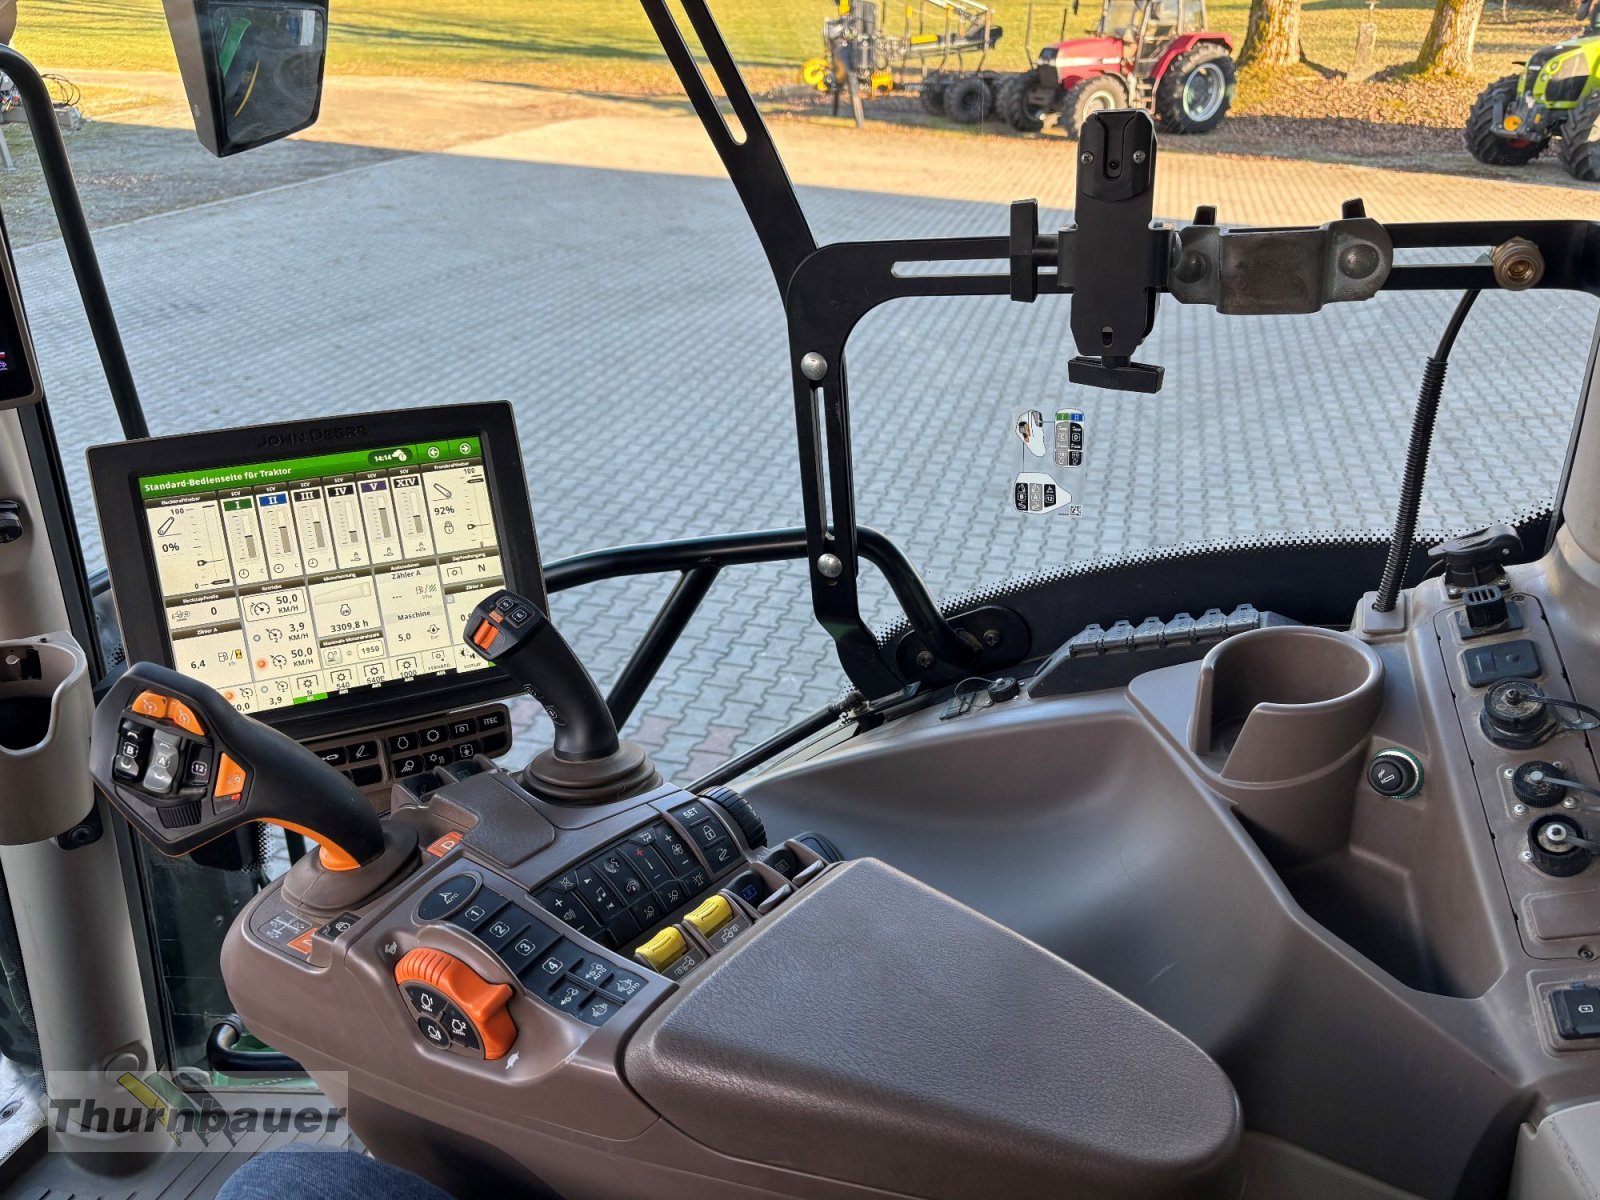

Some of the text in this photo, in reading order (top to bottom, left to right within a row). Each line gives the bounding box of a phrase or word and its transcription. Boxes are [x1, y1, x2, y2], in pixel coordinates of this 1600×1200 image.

[374, 454, 392, 462] 14:14
[144, 467, 292, 492] Standard-Bedienseite für Traktor
[396, 478, 417, 488] XIV
[335, 487, 347, 496] IV
[369, 483, 378, 491] V
[300, 491, 314, 500] III
[268, 496, 278, 505] II
[170, 508, 185, 516] 100
[434, 506, 455, 516] 92%
[162, 542, 180, 553] 0%
[478, 563, 486, 572] N
[276, 594, 298, 605] 50,0
[211, 607, 217, 616] 0
[278, 605, 299, 614] KM/H
[397, 610, 431, 621] Maschine
[289, 622, 305, 633] 3,9
[330, 619, 369, 633] 3309,8 h
[288, 632, 309, 641] KM/H
[398, 633, 412, 643] 5,0
[291, 647, 313, 659] 50,0
[361, 645, 380, 655] 1950
[190, 659, 206, 669] 6,4
[293, 658, 314, 666] KM/H
[336, 682, 350, 690] 540
[269, 696, 283, 705] 3,9
[126, 746, 134, 755] B
[158, 757, 166, 766] A
[194, 764, 204, 772] 12
[682, 807, 698, 819] SET
[445, 893, 459, 905] AUTO
[471, 909, 479, 918] 1
[495, 925, 504, 934] 2
[520, 942, 530, 953] 3
[547, 960, 558, 971] 4
[593, 967, 607, 981] AUTO
[626, 982, 640, 996] AUTO
